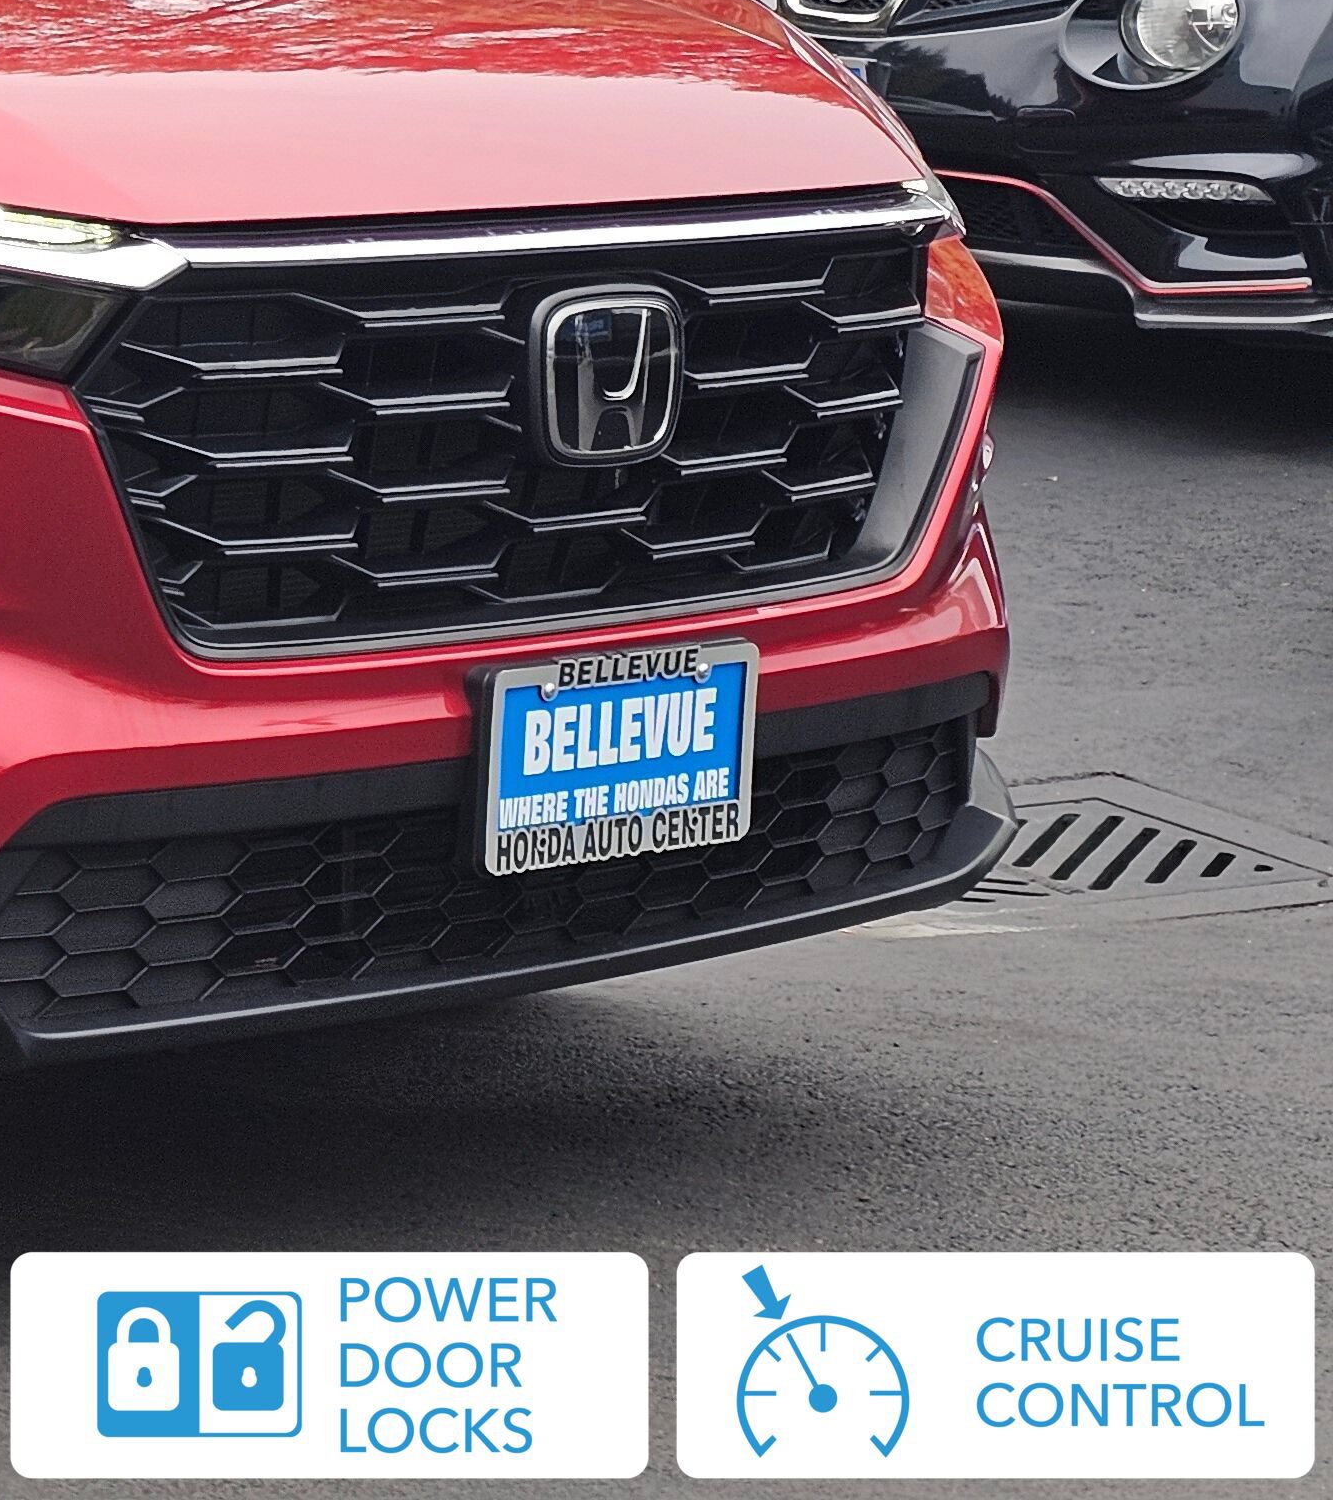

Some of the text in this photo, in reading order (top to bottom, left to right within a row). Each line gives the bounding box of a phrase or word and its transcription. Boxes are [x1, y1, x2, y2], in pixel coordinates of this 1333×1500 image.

[558, 648, 700, 687] BELLEVUE
[523, 687, 717, 776] BELLEVUE
[499, 767, 730, 829] WHERE THE HONDAS ARE
[496, 802, 740, 872] HONDA AUTO CENTER
